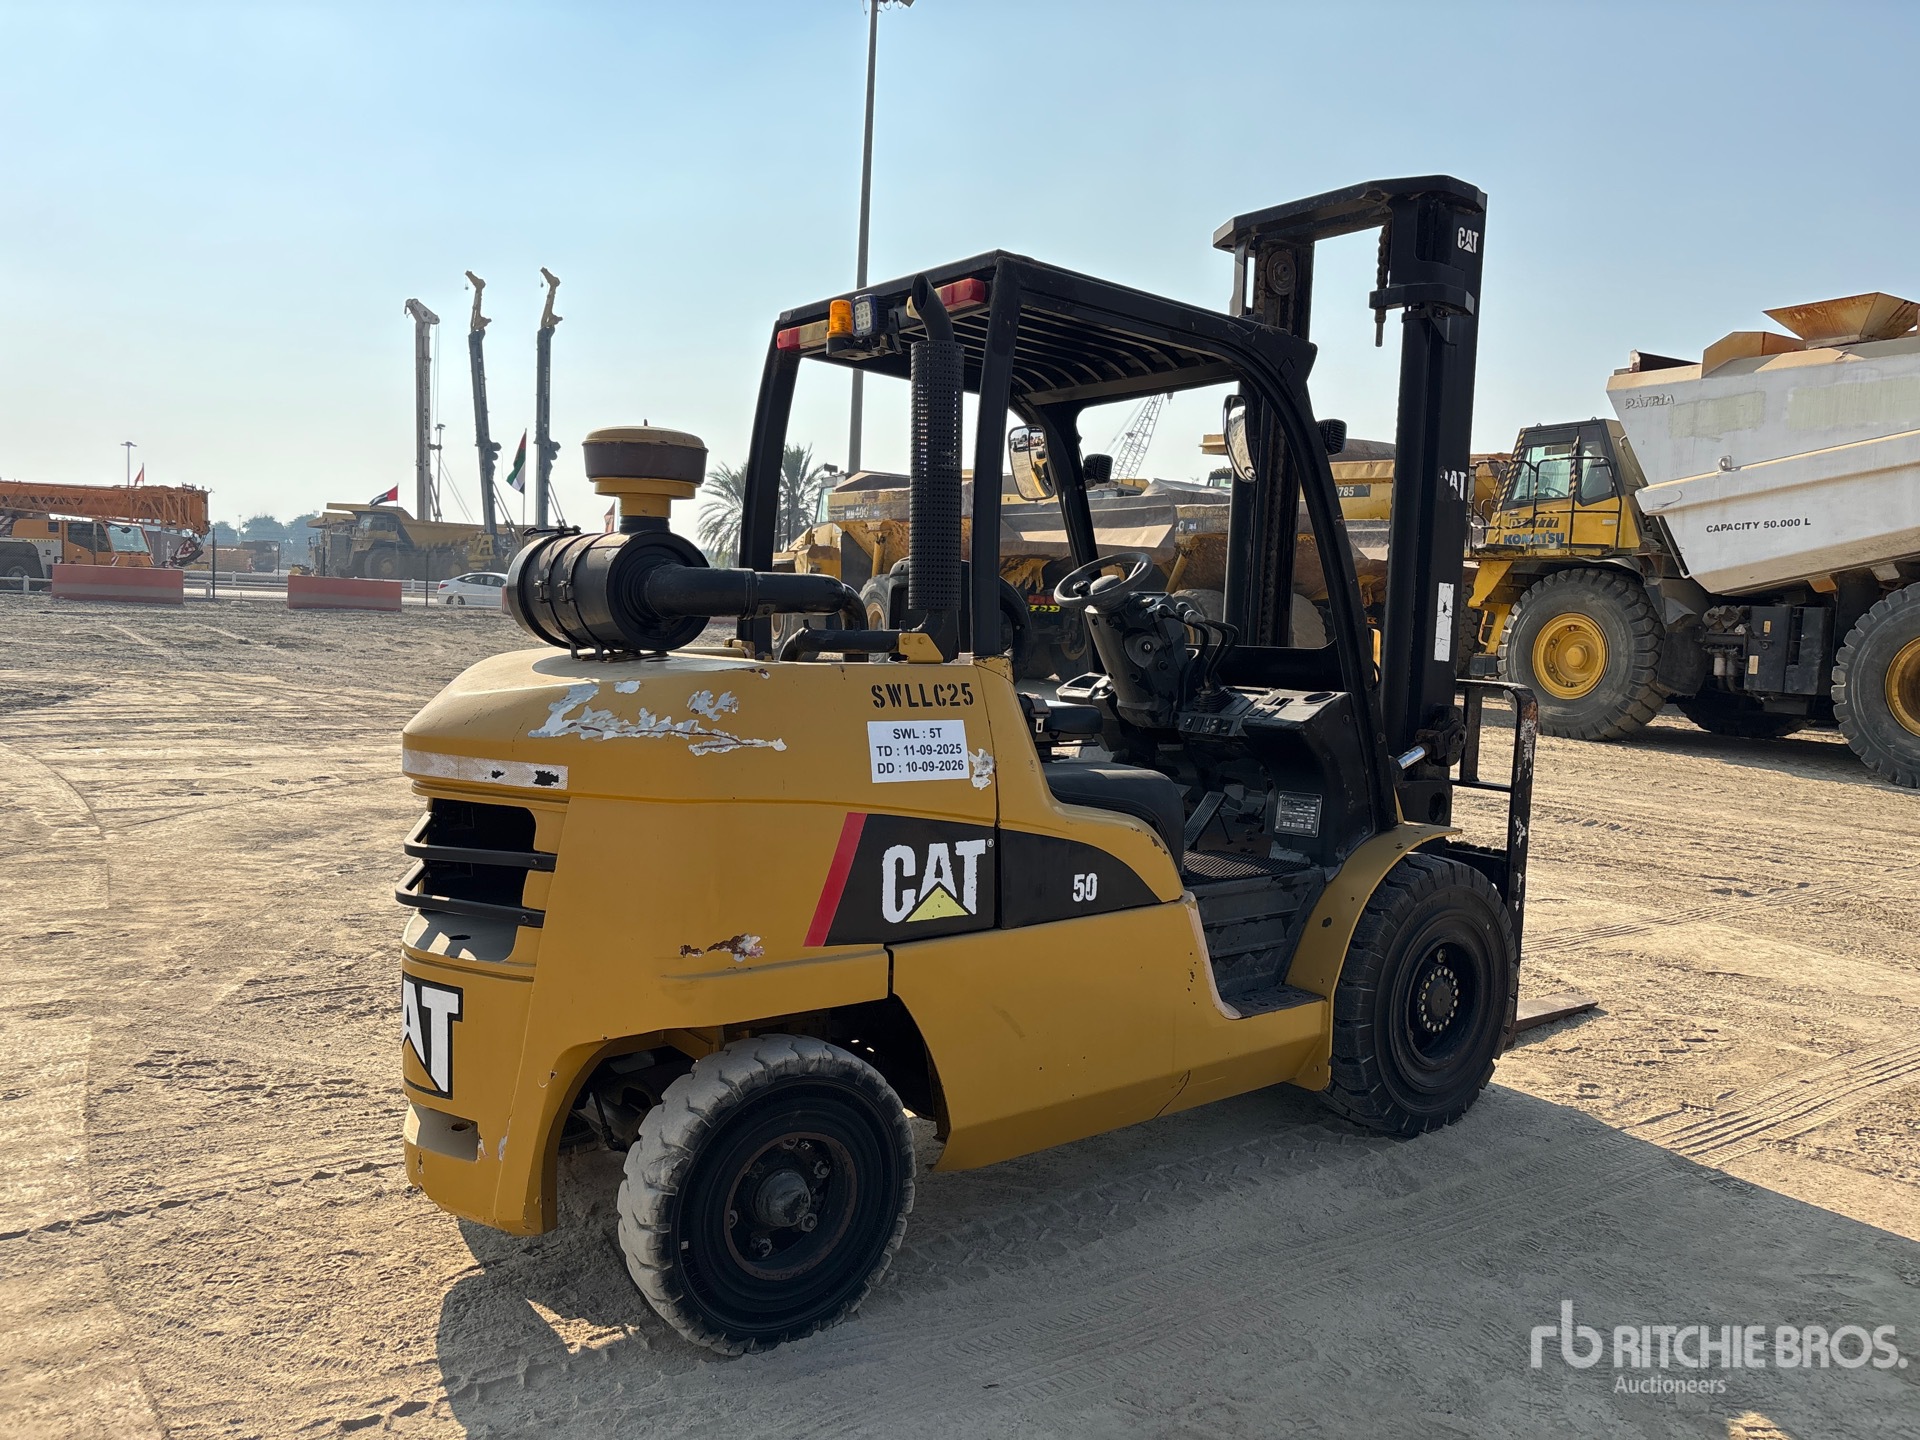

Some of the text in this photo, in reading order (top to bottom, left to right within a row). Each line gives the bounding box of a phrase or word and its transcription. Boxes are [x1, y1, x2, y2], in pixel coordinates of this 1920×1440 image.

[1457, 226, 1479, 254] CAT
[1440, 470, 1467, 502] AT
[1503, 532, 1565, 545] KOMATSU
[1706, 517, 1811, 533] CAPACITY 50.000 L
[871, 682, 974, 709] SWLLC25
[892, 728, 920, 740] SWL
[929, 727, 942, 739] 5T
[876, 745, 893, 757] TD
[903, 743, 962, 756] 11-09-2025
[877, 762, 895, 774] DD
[905, 759, 964, 773] 10-09-2026
[881, 838, 987, 924] CAT
[1072, 872, 1098, 903] 50
[402, 978, 459, 1093] AT
